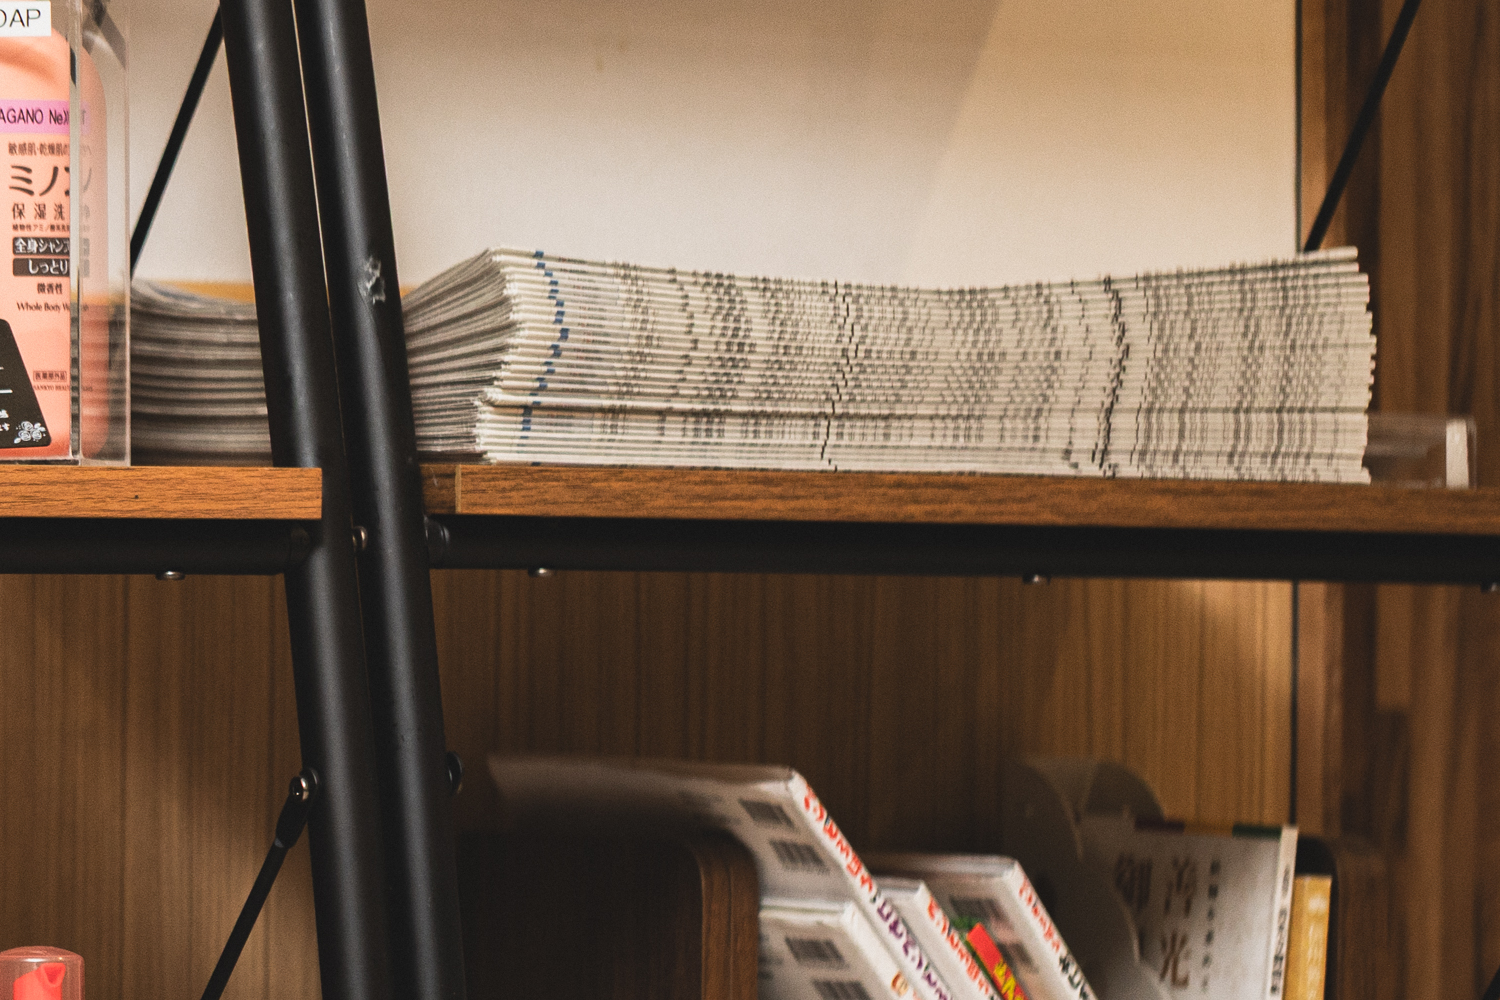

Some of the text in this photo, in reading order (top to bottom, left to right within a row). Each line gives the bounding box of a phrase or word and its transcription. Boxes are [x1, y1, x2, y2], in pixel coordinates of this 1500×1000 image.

[27, 258, 69, 275] しっとり
[16, 301, 43, 313] Whole
[44, 301, 61, 314] Body
